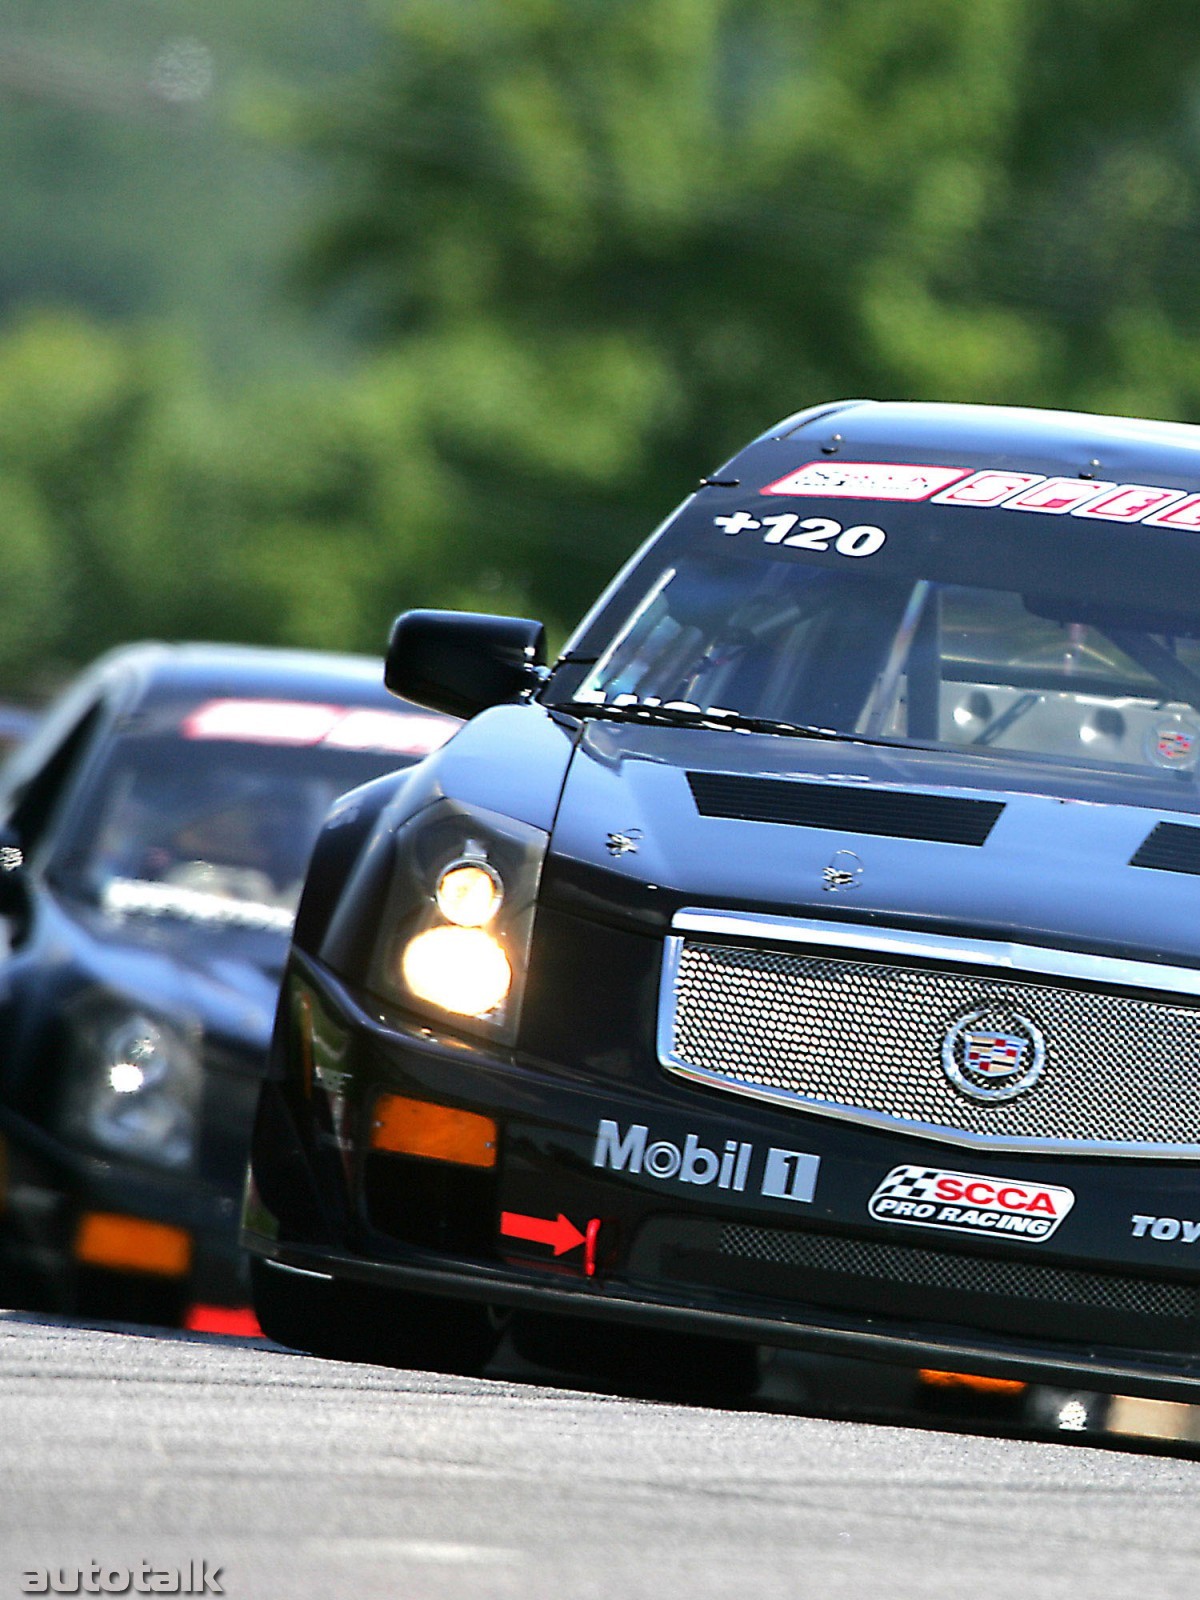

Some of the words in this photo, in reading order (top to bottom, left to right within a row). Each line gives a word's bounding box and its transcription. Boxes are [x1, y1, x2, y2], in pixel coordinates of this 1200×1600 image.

[714, 510, 886, 557] +120
[593, 1119, 752, 1192] Mobil
[876, 1197, 938, 1223] PRO
[938, 1207, 1055, 1237] RACING
[934, 1177, 1059, 1216] SCCA
